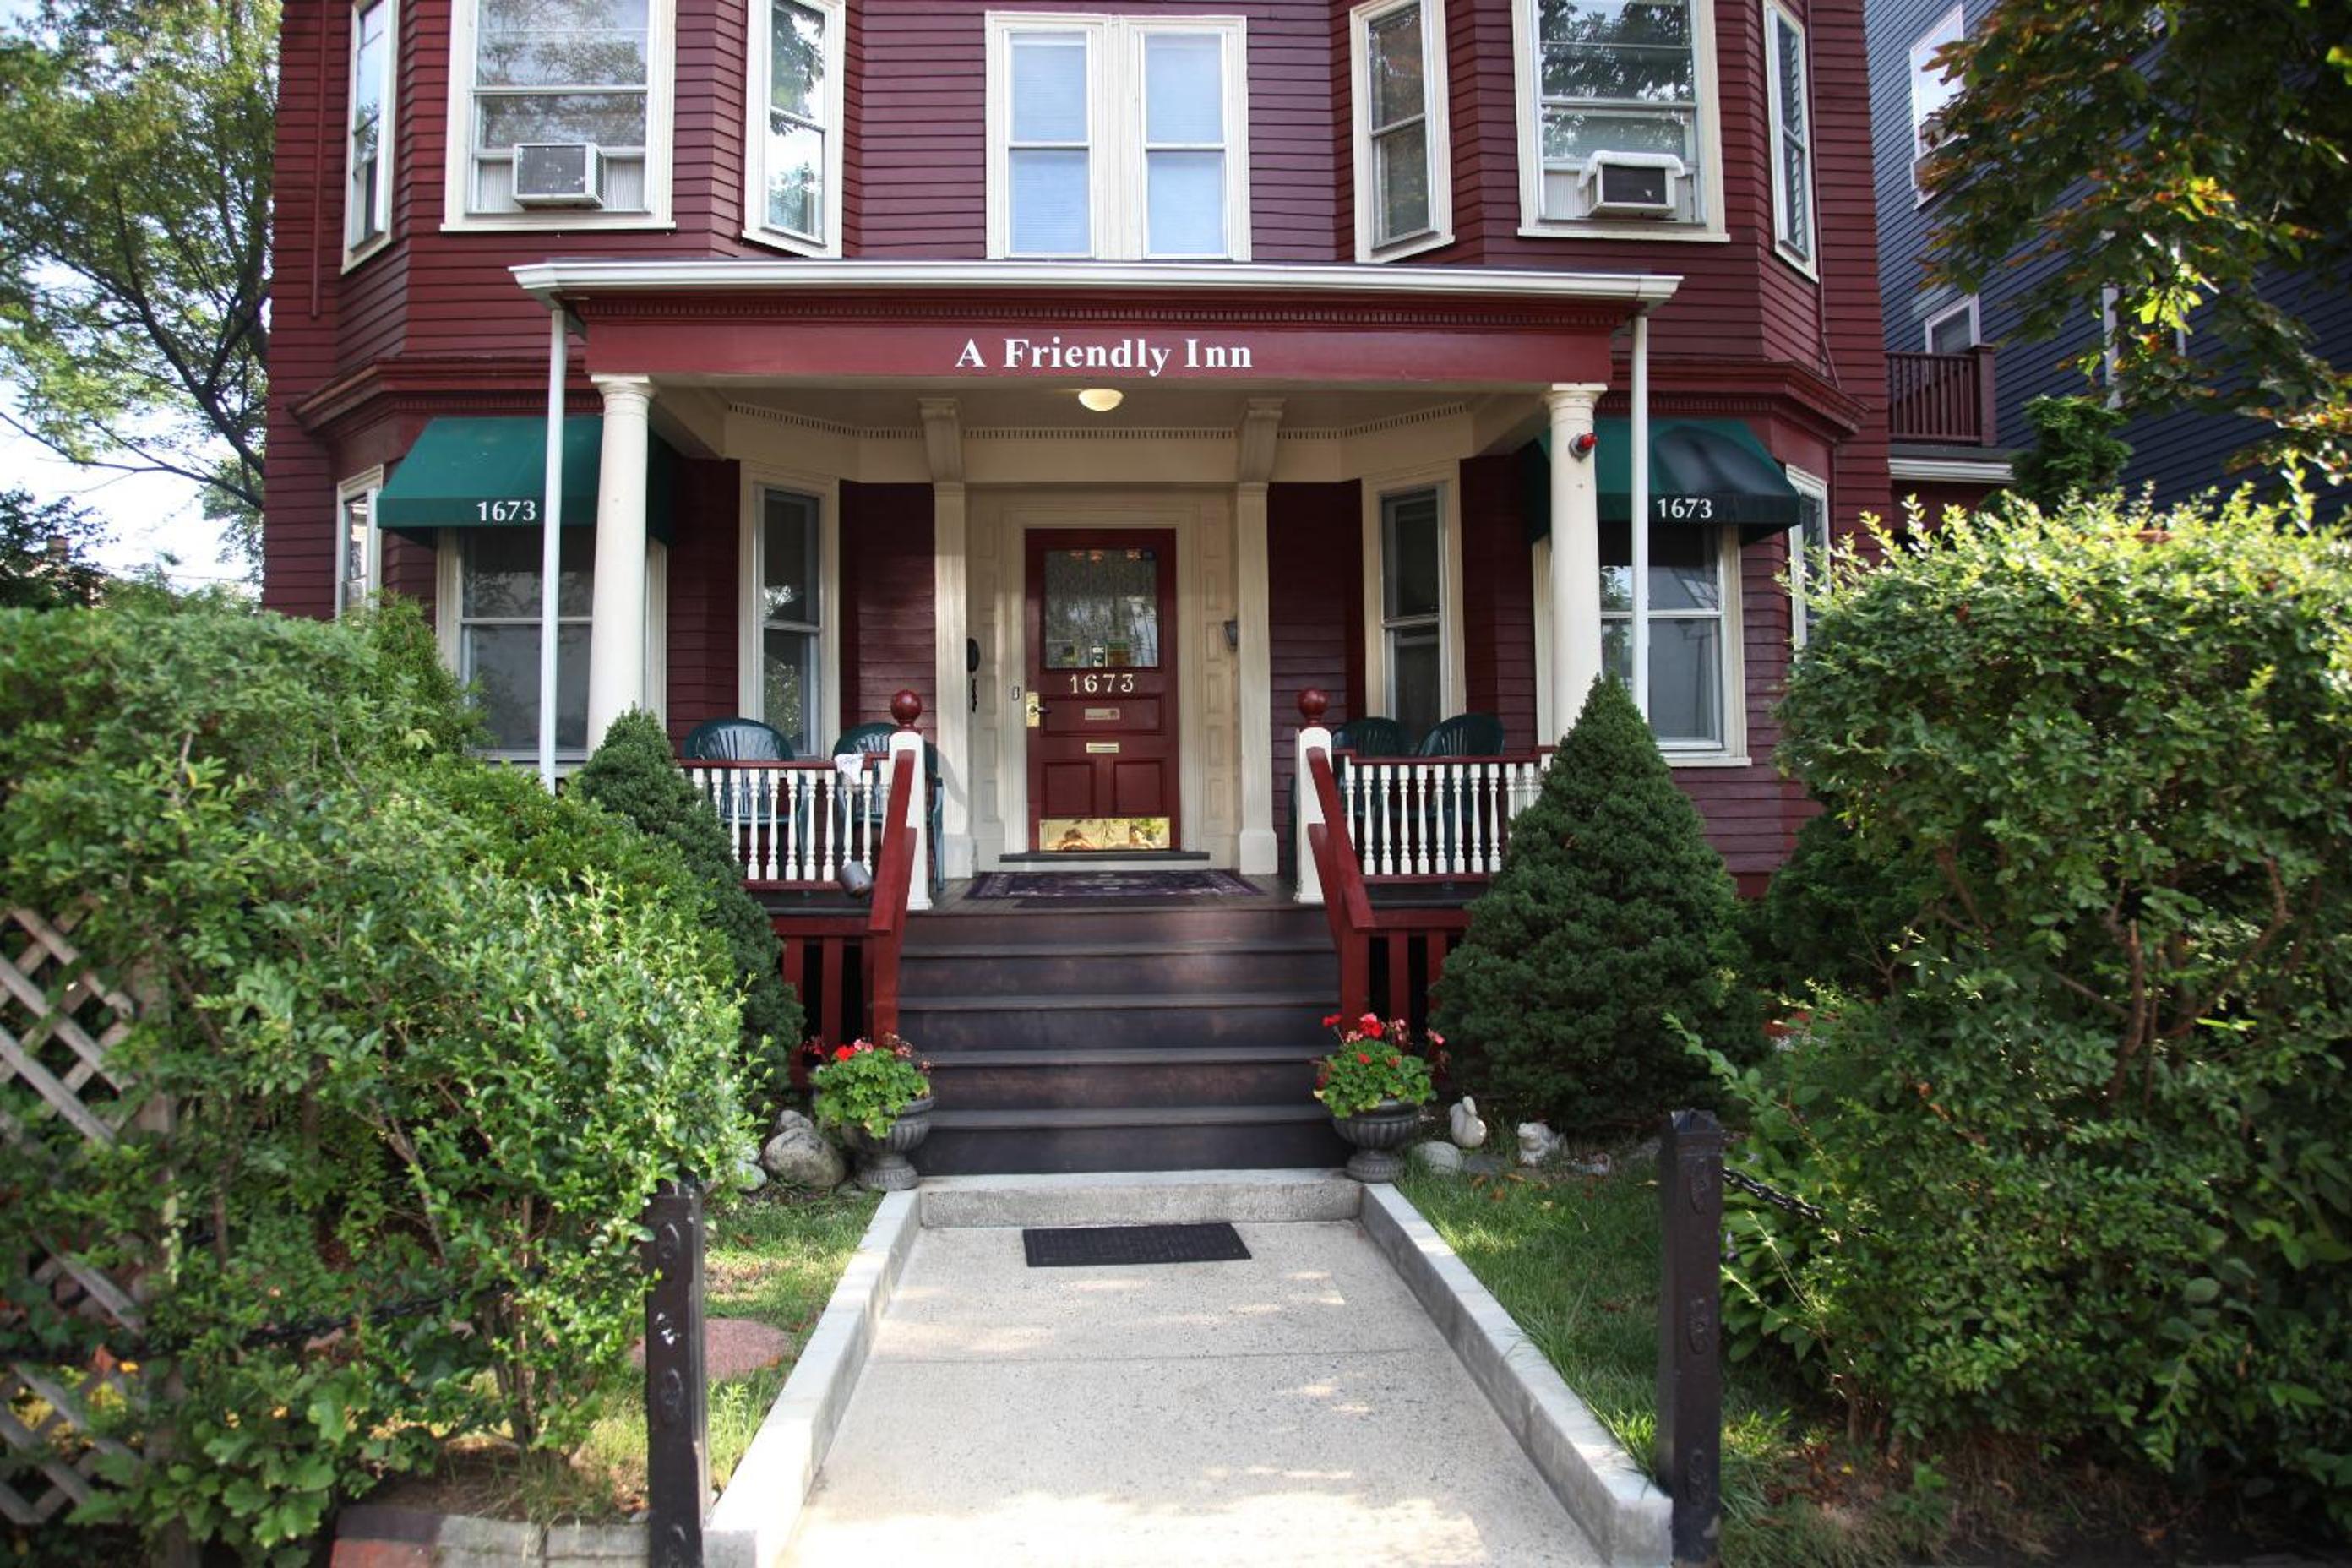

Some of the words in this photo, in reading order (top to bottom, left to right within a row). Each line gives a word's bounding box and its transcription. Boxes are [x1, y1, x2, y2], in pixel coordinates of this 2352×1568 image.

[956, 338, 987, 368] A
[1003, 336, 1171, 377] Friendly
[1184, 338, 1252, 368] Inn
[476, 500, 536, 521] 1673
[1657, 498, 1713, 519] 1673
[1070, 673, 1134, 694] 1673
